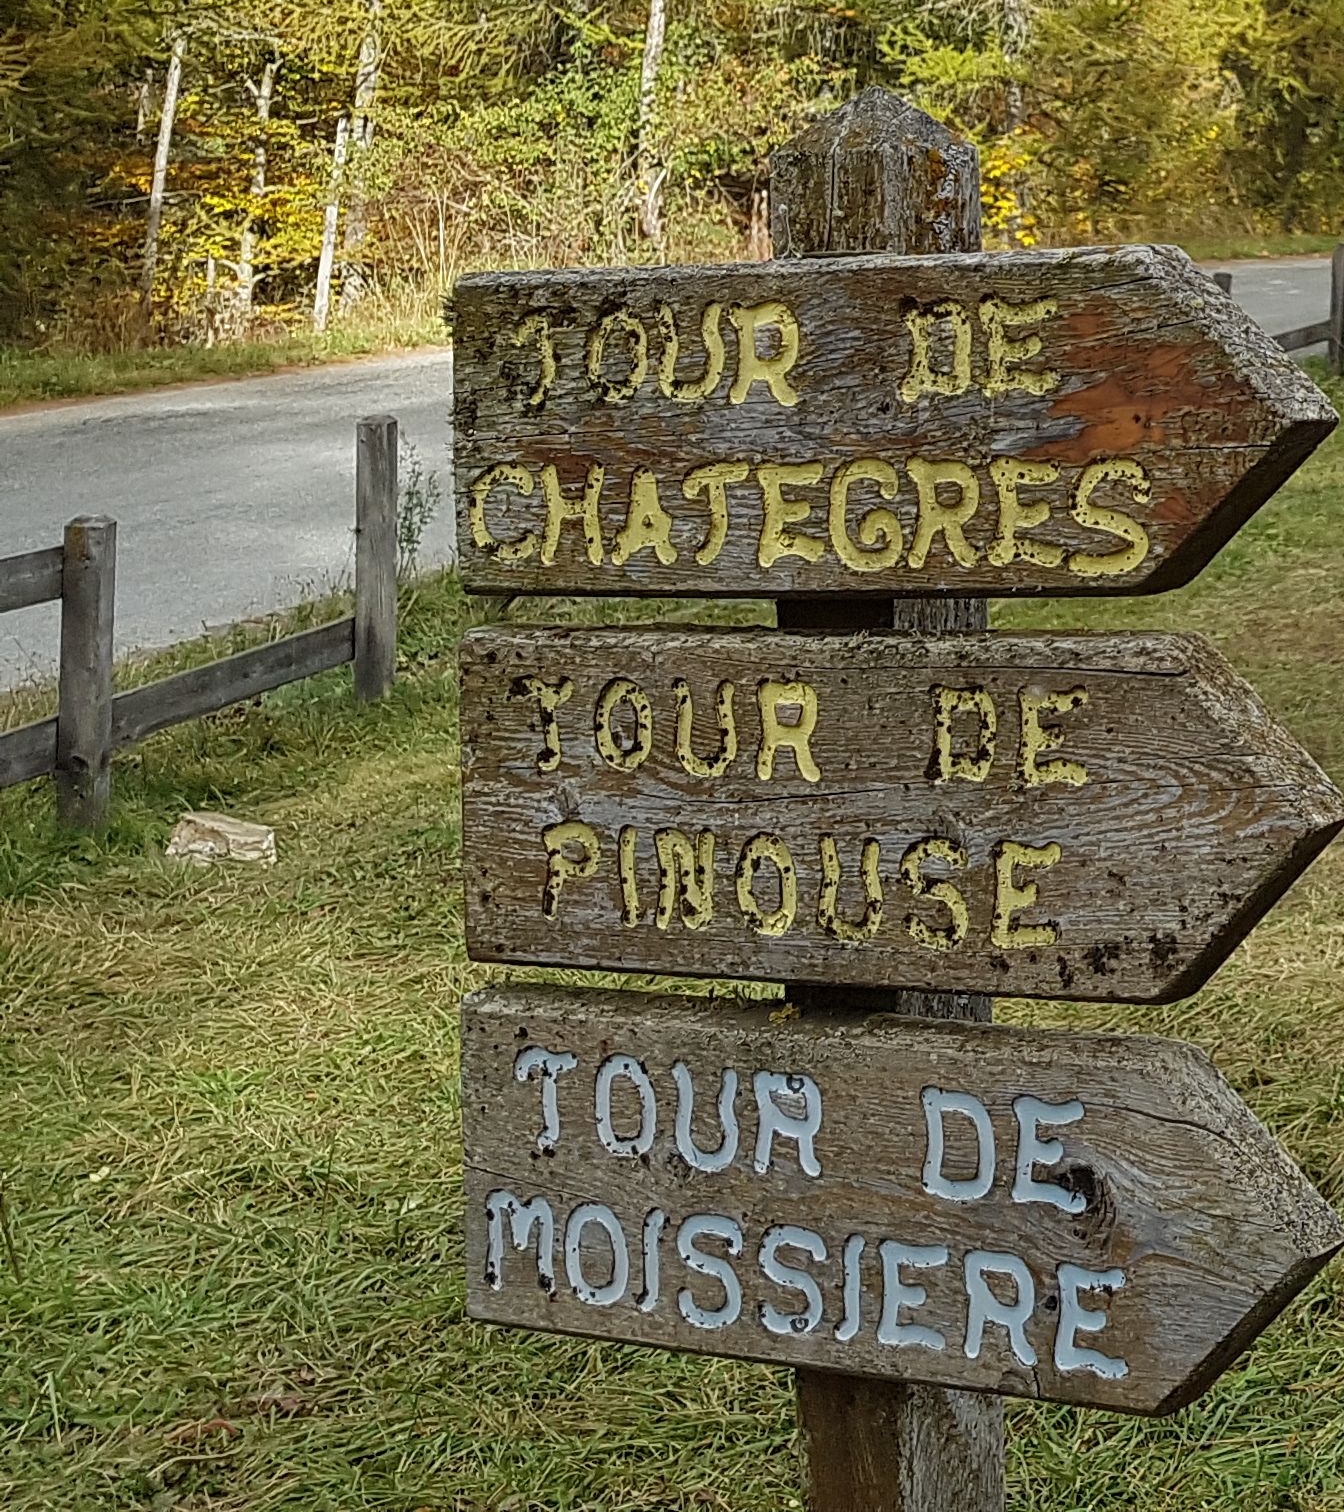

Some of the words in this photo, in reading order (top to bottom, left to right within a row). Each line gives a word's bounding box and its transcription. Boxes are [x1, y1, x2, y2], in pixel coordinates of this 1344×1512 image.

[511, 298, 800, 408] TOUR
[900, 294, 1060, 403] DE
[469, 457, 1152, 576] CHATEGRES
[507, 676, 822, 783] TOUR
[925, 683, 1090, 787] DE
[540, 821, 1062, 950] PINOUSE
[513, 1045, 823, 1178] TOUR
[920, 1084, 1086, 1214] DE
[483, 1188, 1128, 1380] MOISSIERE
